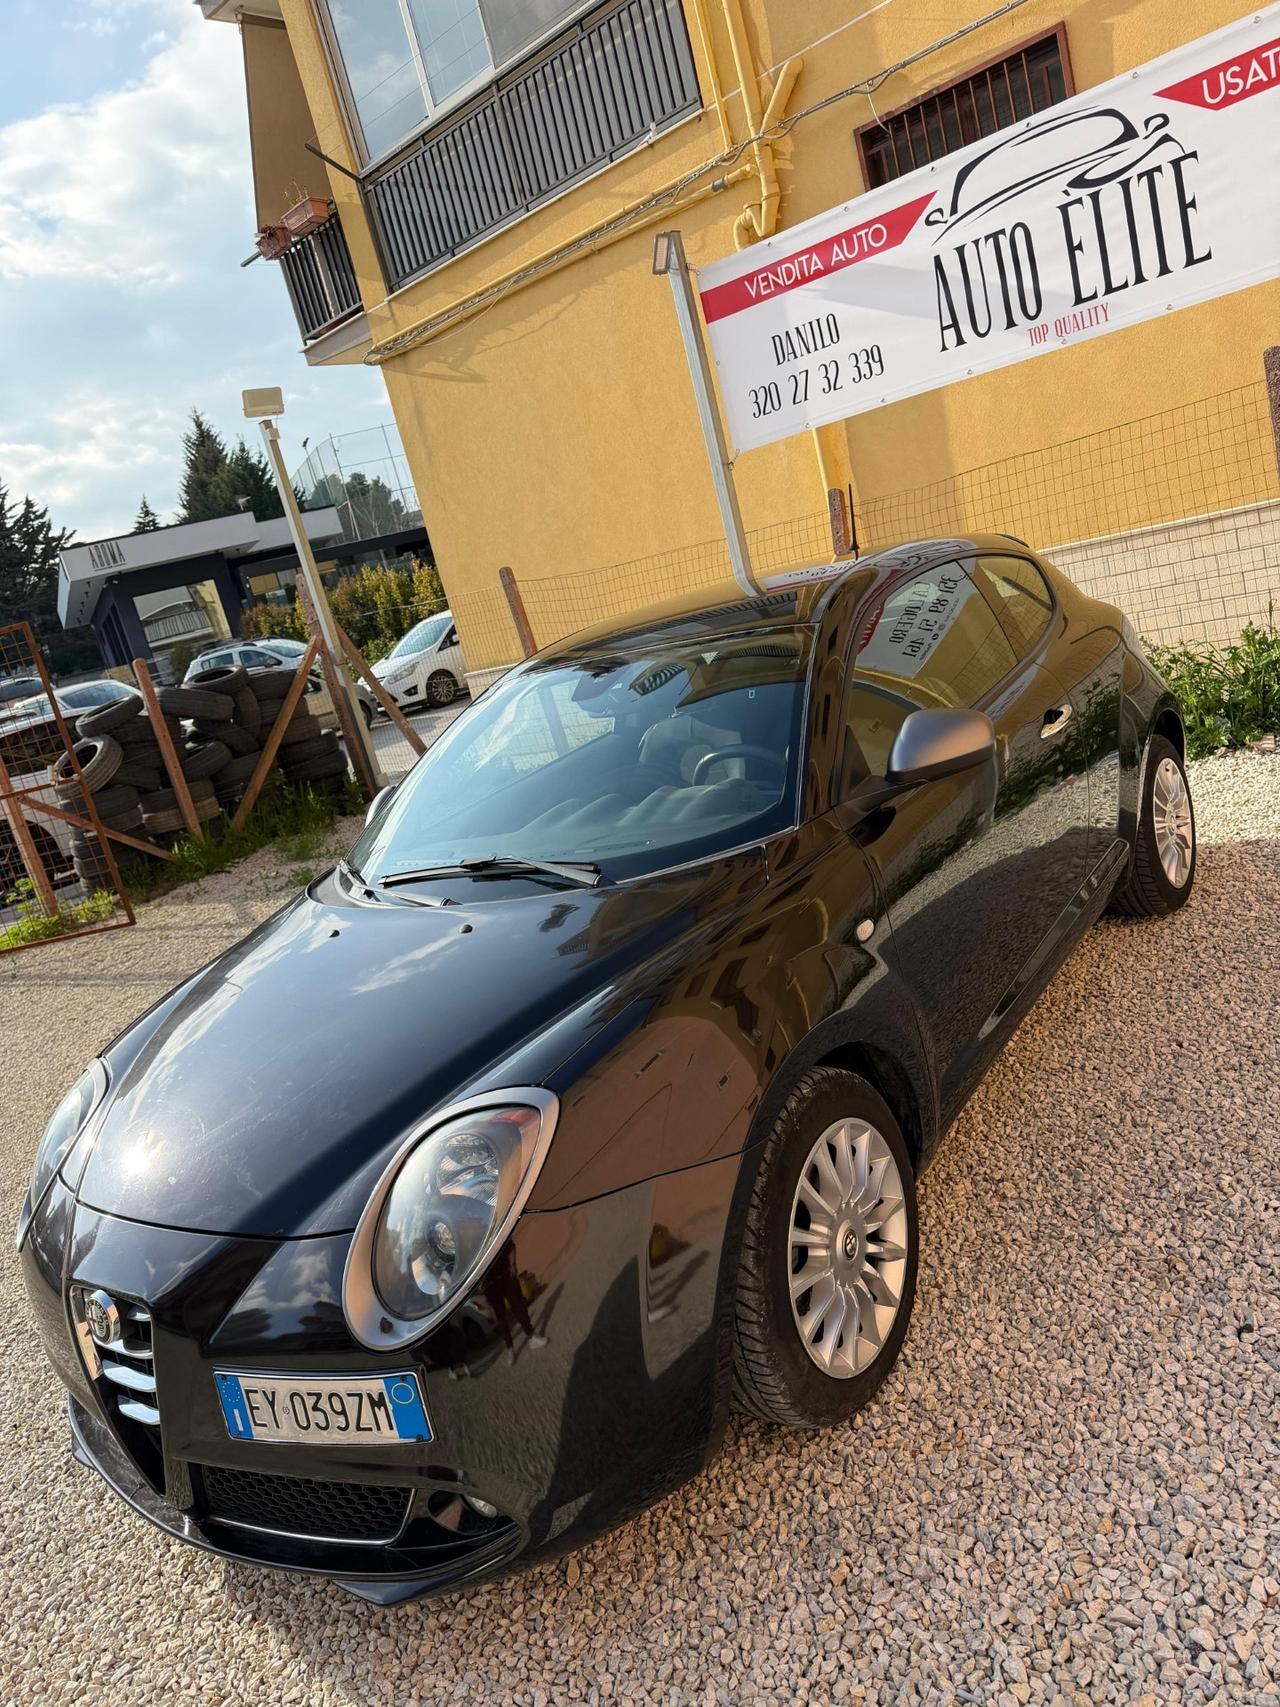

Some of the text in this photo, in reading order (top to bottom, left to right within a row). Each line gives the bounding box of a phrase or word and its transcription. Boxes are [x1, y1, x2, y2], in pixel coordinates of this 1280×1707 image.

[1202, 47, 1280, 104] USAT
[744, 223, 888, 299] VENDITA AUTO
[933, 221, 1043, 352] AUTO
[771, 313, 841, 366] DANILO
[1027, 302, 1111, 347] TOP QUALITY
[748, 344, 885, 419] 320 27 32 339
[88, 540, 126, 569] AROMA
[244, 1388, 394, 1432] EY 039ZM
